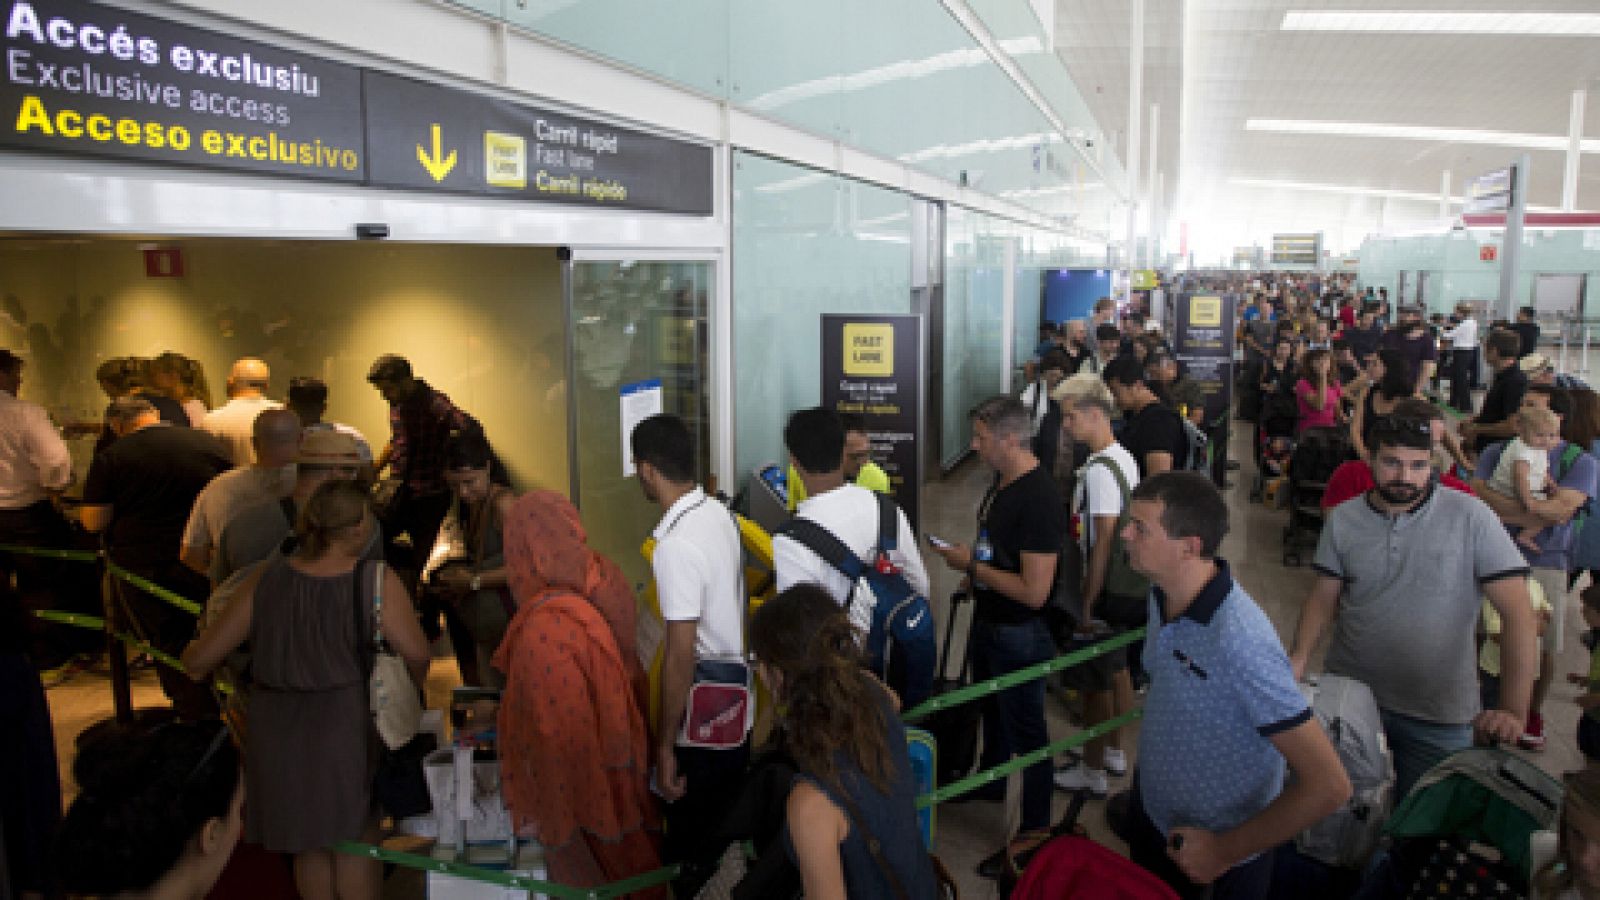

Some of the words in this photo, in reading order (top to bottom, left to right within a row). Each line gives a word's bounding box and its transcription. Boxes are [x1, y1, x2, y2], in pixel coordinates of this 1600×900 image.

[6, 2, 160, 65] Accés
[170, 44, 321, 97] exclusiu
[6, 47, 181, 108] Exclusive
[189, 88, 291, 126] access
[16, 95, 191, 150] Acceso
[202, 129, 358, 170] exclusivo
[852, 336, 883, 347] FAST
[852, 352, 883, 363] LANE
